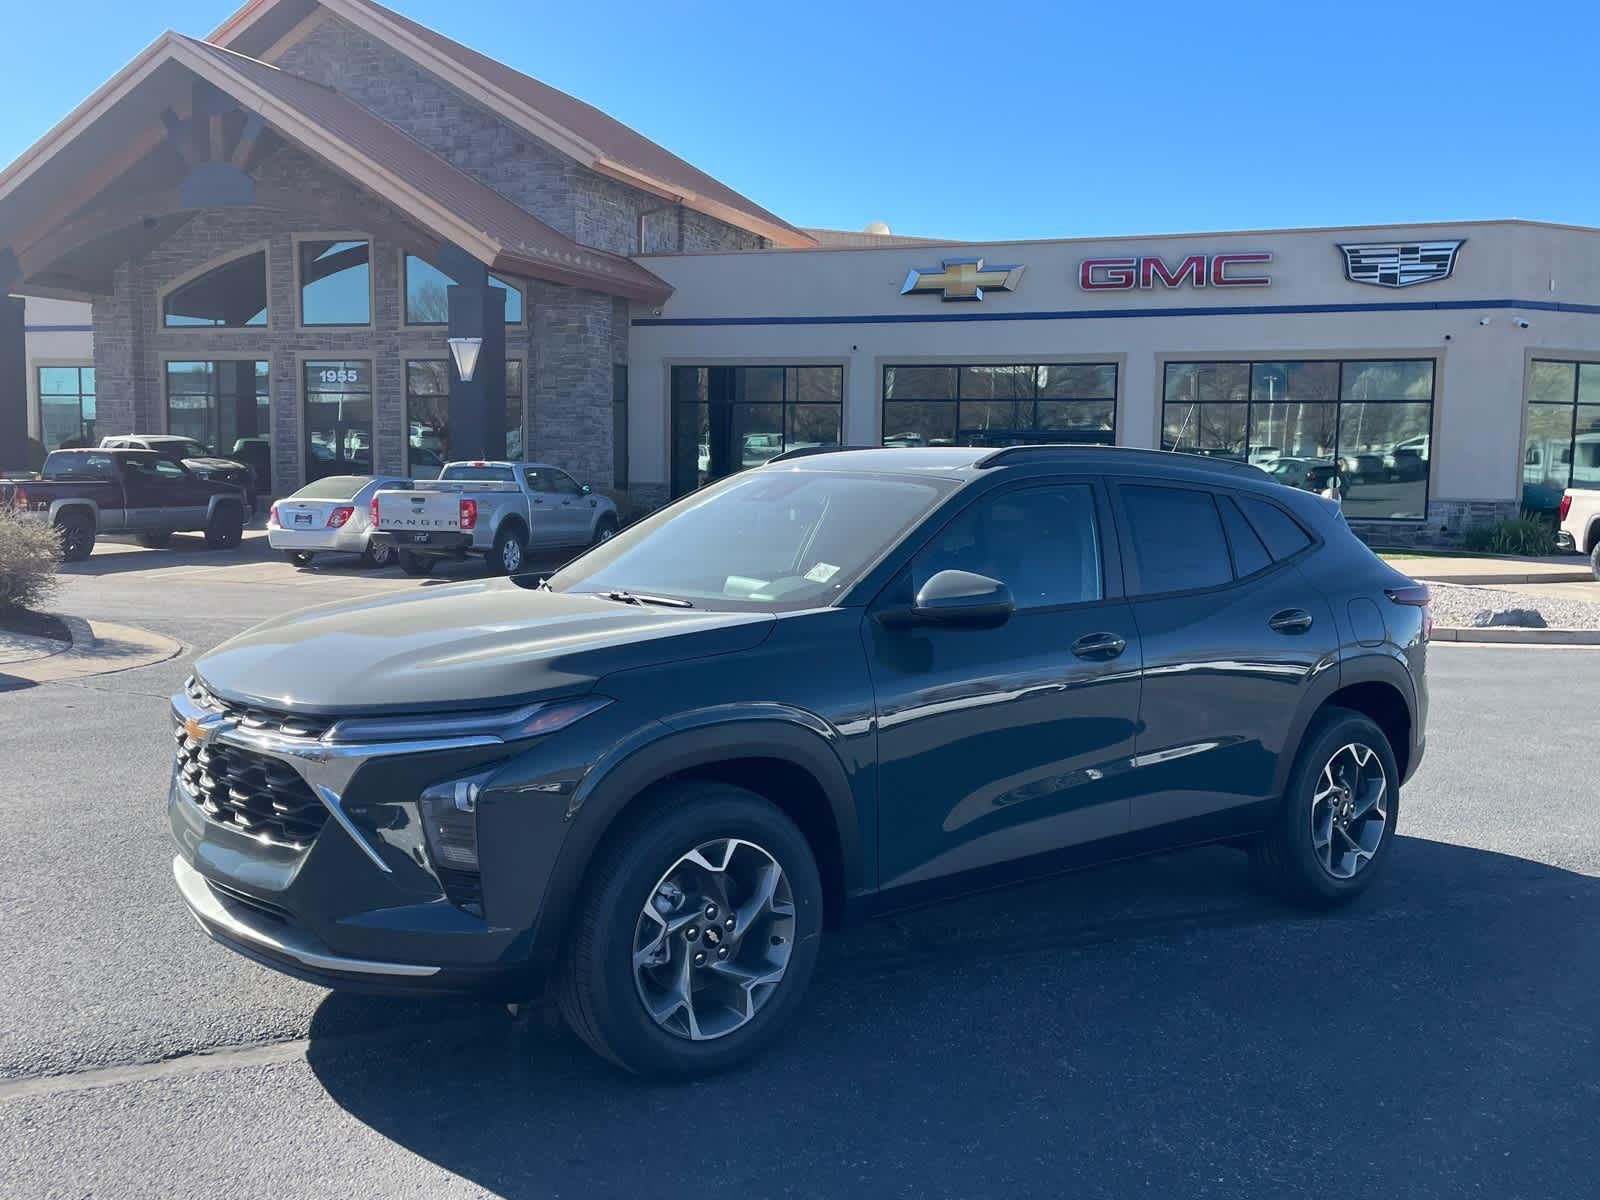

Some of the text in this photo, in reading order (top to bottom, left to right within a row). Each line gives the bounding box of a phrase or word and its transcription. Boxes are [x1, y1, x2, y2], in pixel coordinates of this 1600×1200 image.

[1079, 253, 1272, 291] GMC
[319, 370, 358, 382] 1955
[381, 519, 458, 527] RANGER
